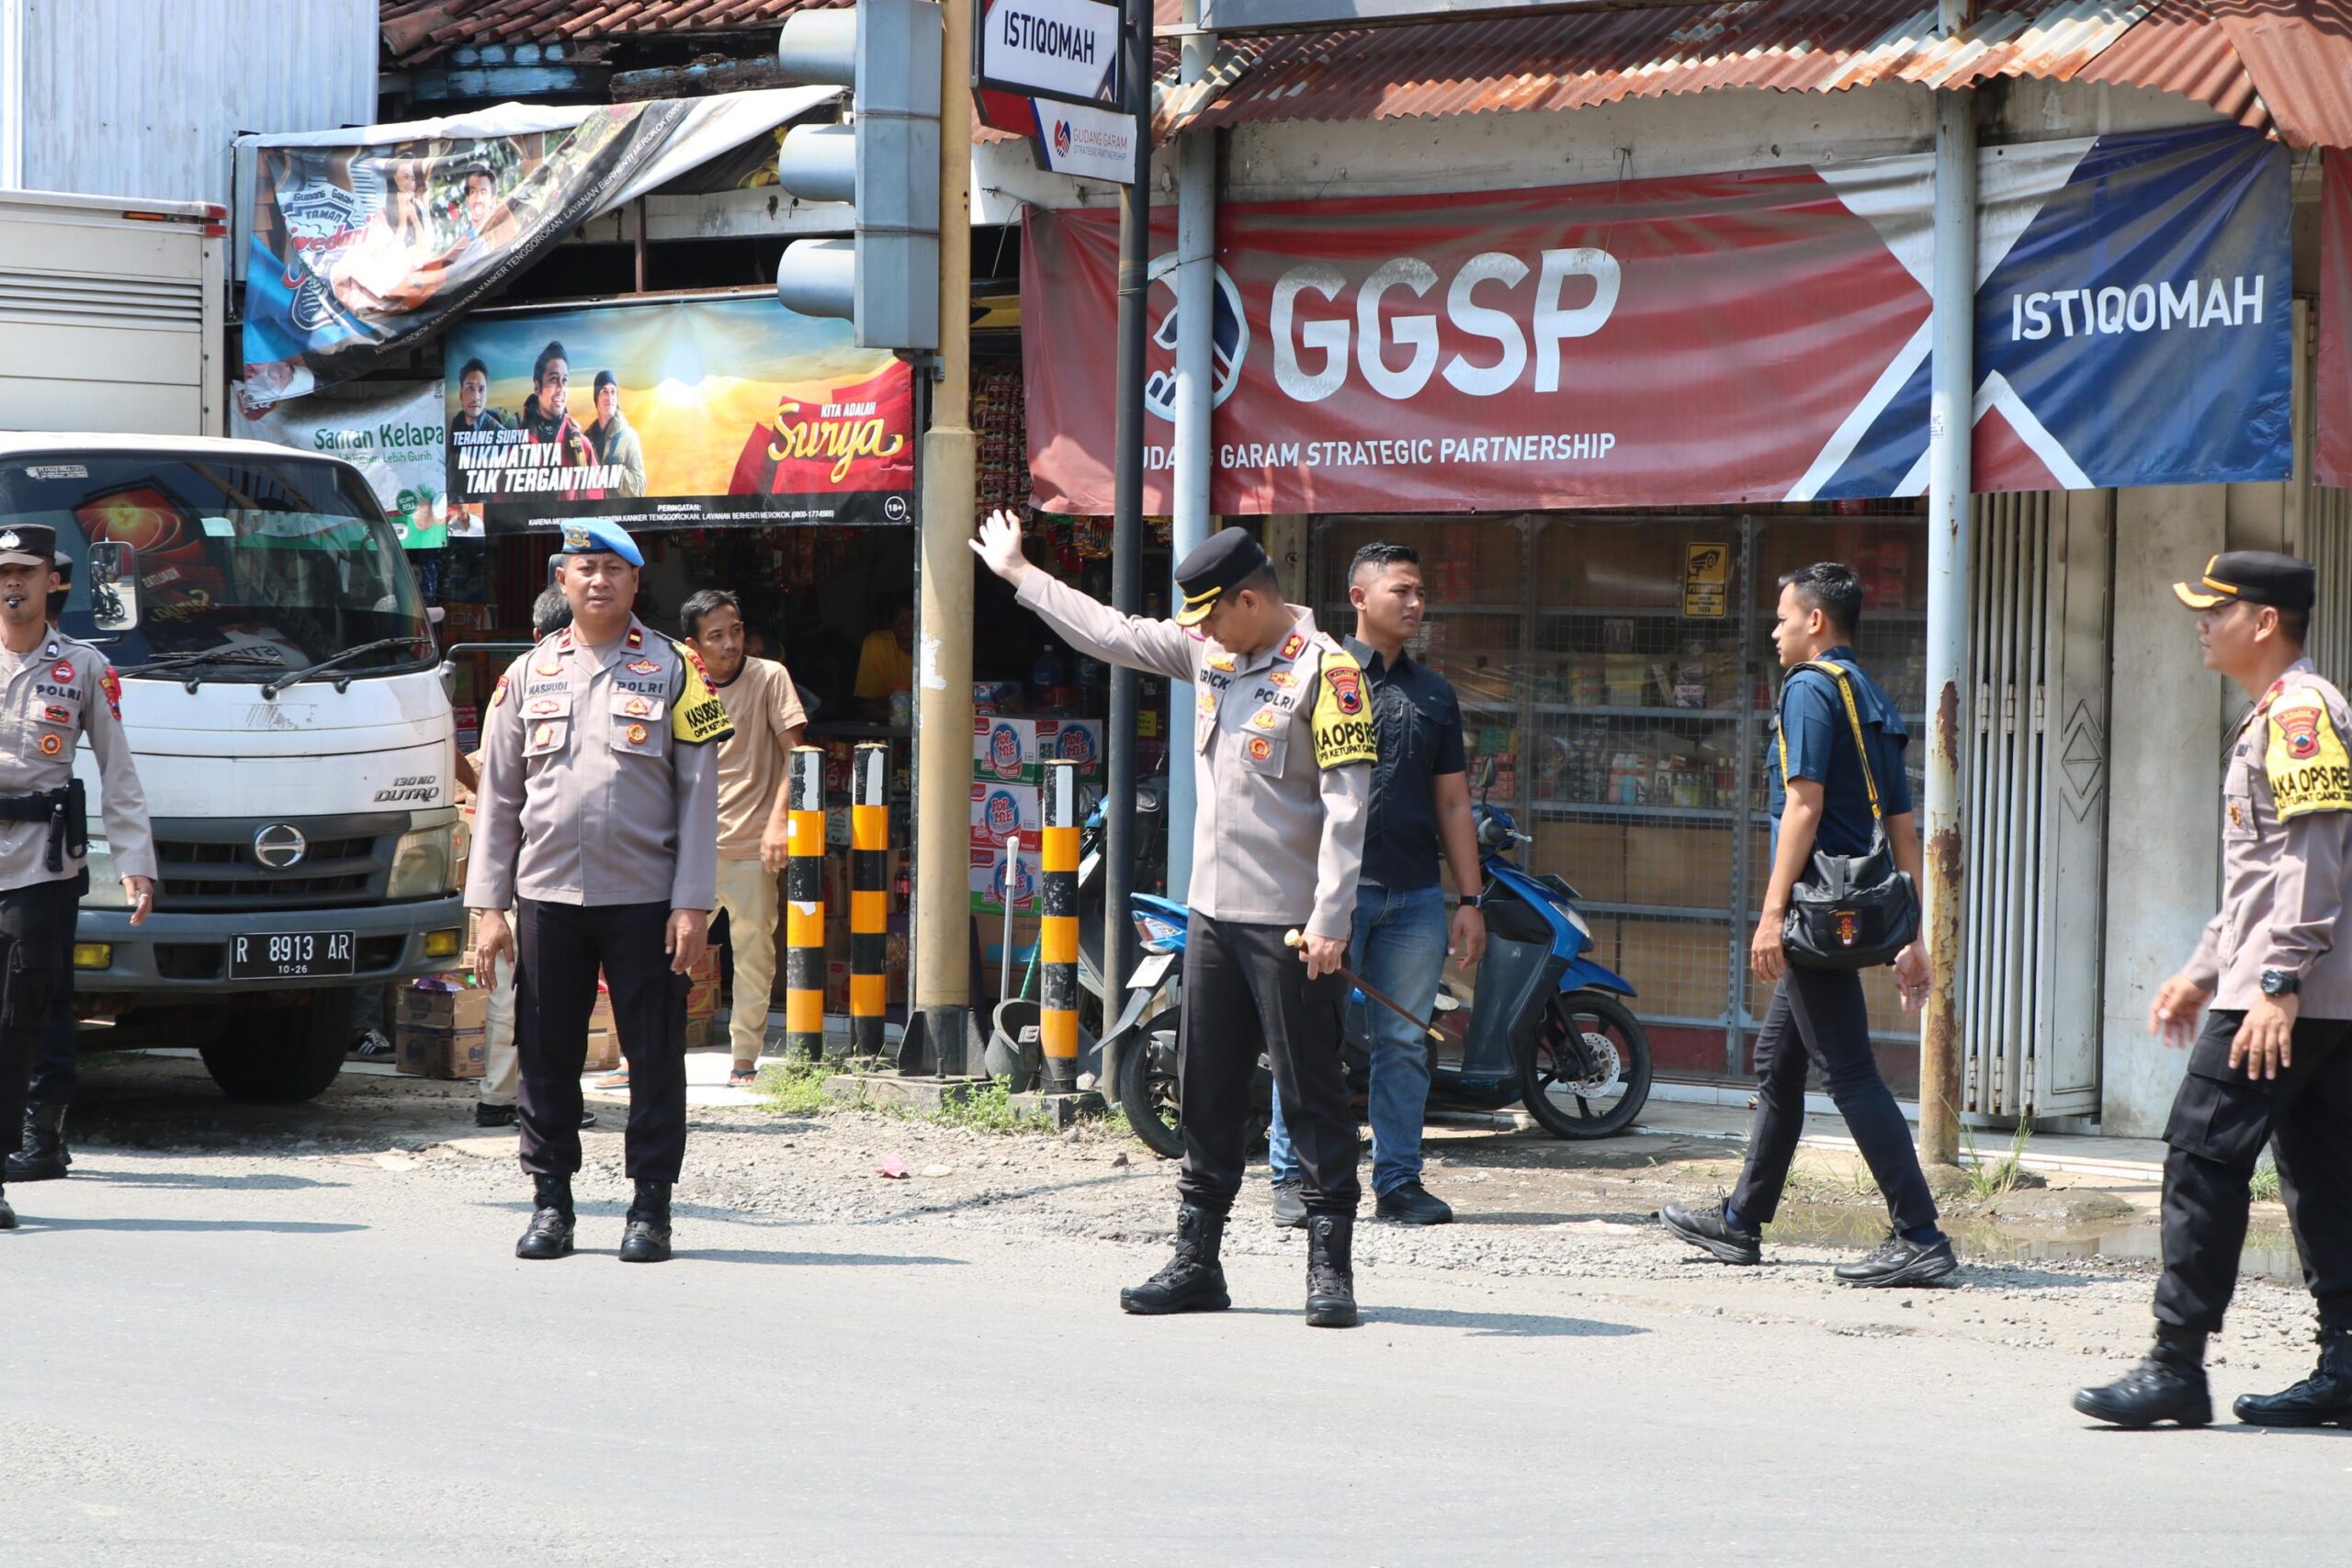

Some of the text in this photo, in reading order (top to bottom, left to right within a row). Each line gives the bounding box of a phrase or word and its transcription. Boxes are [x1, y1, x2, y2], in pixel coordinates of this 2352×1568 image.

[1004, 10, 1095, 65] ISTIQOMAH
[1073, 129, 1127, 150] GUDANG GARAM
[563, 186, 599, 220] LAYANAN
[597, 153, 634, 190] BERHENTI
[632, 120, 667, 156] MEROKOK
[305, 209, 343, 223] TAMAN
[2011, 275, 2265, 342] ISTIQOMAH
[1269, 246, 1623, 403] GGSP
[820, 401, 876, 418] KITA ADALAH
[379, 423, 445, 448] Kelapa
[453, 429, 529, 446] TERANG SURYA
[767, 402, 904, 483] Surya
[382, 452, 406, 463] Lebih
[408, 451, 432, 462] Gurih
[458, 443, 561, 469] NIKMATNYA
[1220, 443, 1299, 469] GARAM
[1306, 438, 1433, 467] STRATEGIC
[1440, 433, 1617, 464] PARTNERSHIP
[467, 464, 623, 494] TAK TERGANTIKAN
[657, 504, 702, 513] PERINGATAN:
[888, 503, 903, 513] 18+
[528, 518, 552, 526] KARENA
[623, 513, 648, 522] KANKER
[732, 512, 760, 520] BERHENTI
[760, 511, 791, 520] MEROKOK
[37, 684, 81, 701] POLRI
[616, 681, 663, 694] POLRI
[1254, 688, 1295, 711] POLRI
[995, 731, 1012, 747] POP
[999, 744, 1015, 757] MIE
[1067, 744, 1088, 756] MIE
[1329, 745, 1362, 758] KETUPAT
[393, 776, 417, 787] 130
[373, 786, 440, 803] DUTRO
[991, 798, 1009, 813] POP
[994, 809, 1012, 824] MIE
[236, 934, 350, 963] R 8913 AR
